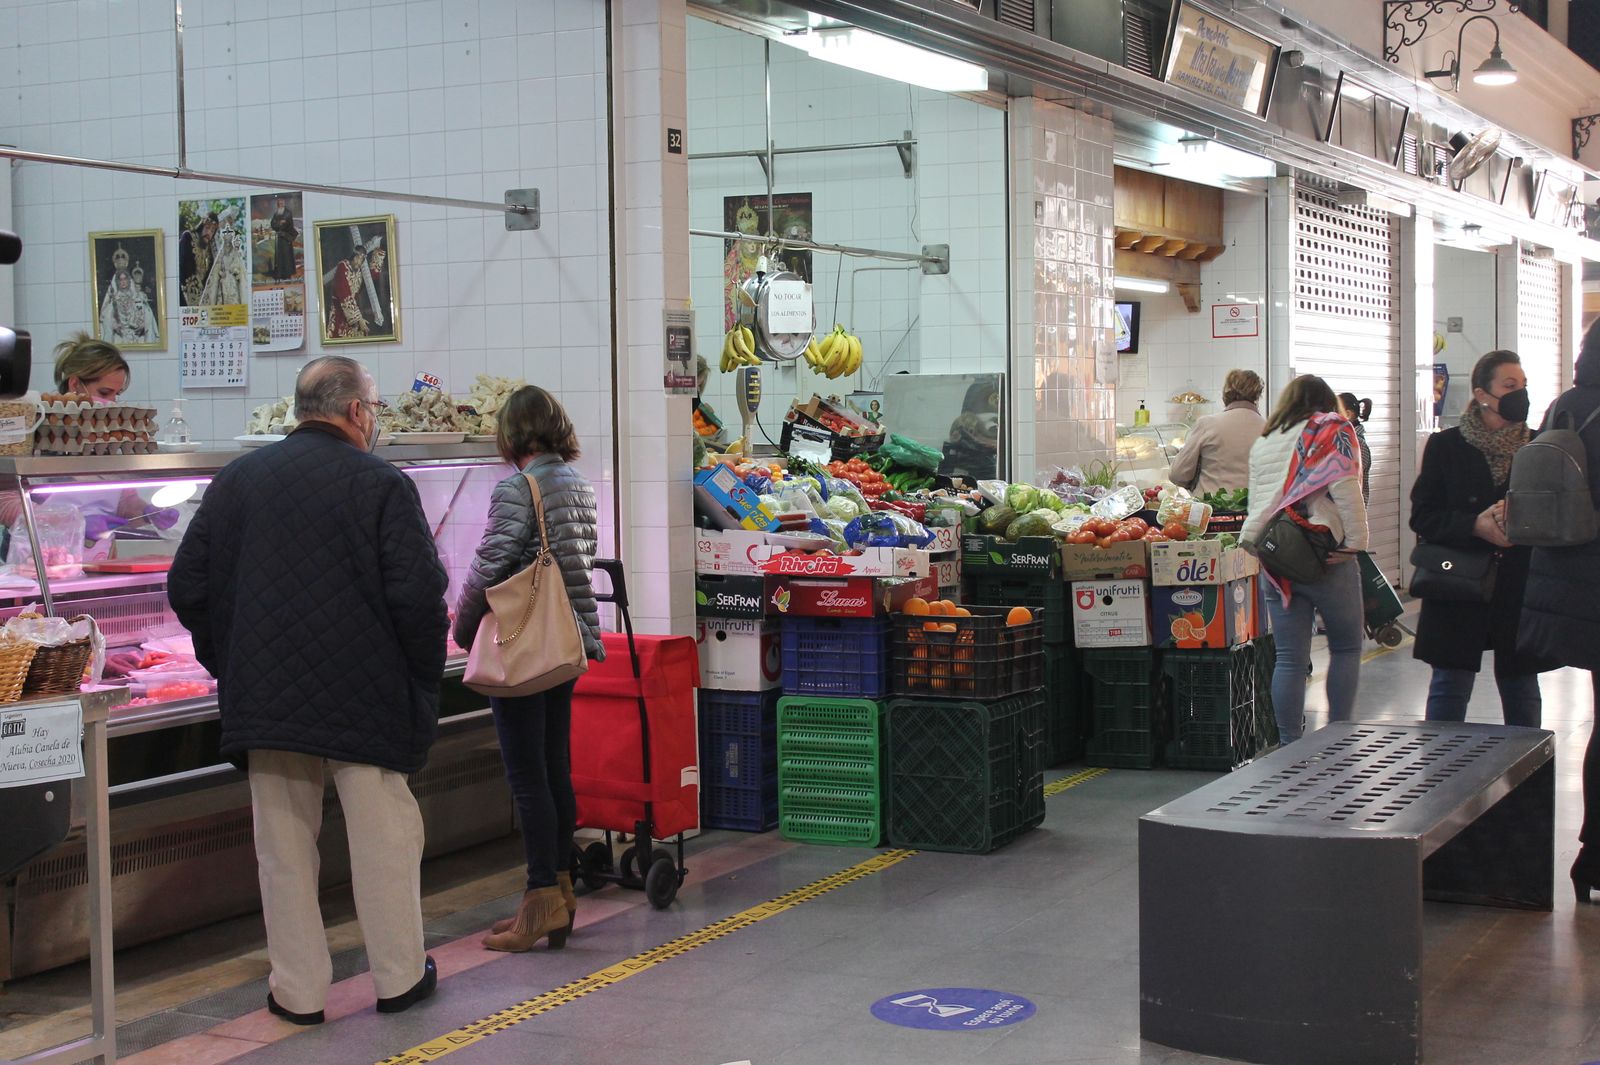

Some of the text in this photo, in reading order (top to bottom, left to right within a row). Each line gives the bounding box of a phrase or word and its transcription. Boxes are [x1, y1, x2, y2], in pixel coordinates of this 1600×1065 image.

[670, 133, 681, 147] 32
[182, 316, 199, 326] STOP
[779, 555, 881, 575] Rivoira Apples
[1096, 585, 1140, 596] unifrutti
[816, 589, 867, 608] Lucas
[32, 727, 49, 740] Hay
[6, 738, 71, 758] Alubia Canela de
[28, 754, 57, 769] Cosecha
[58, 753, 76, 765] 2020
